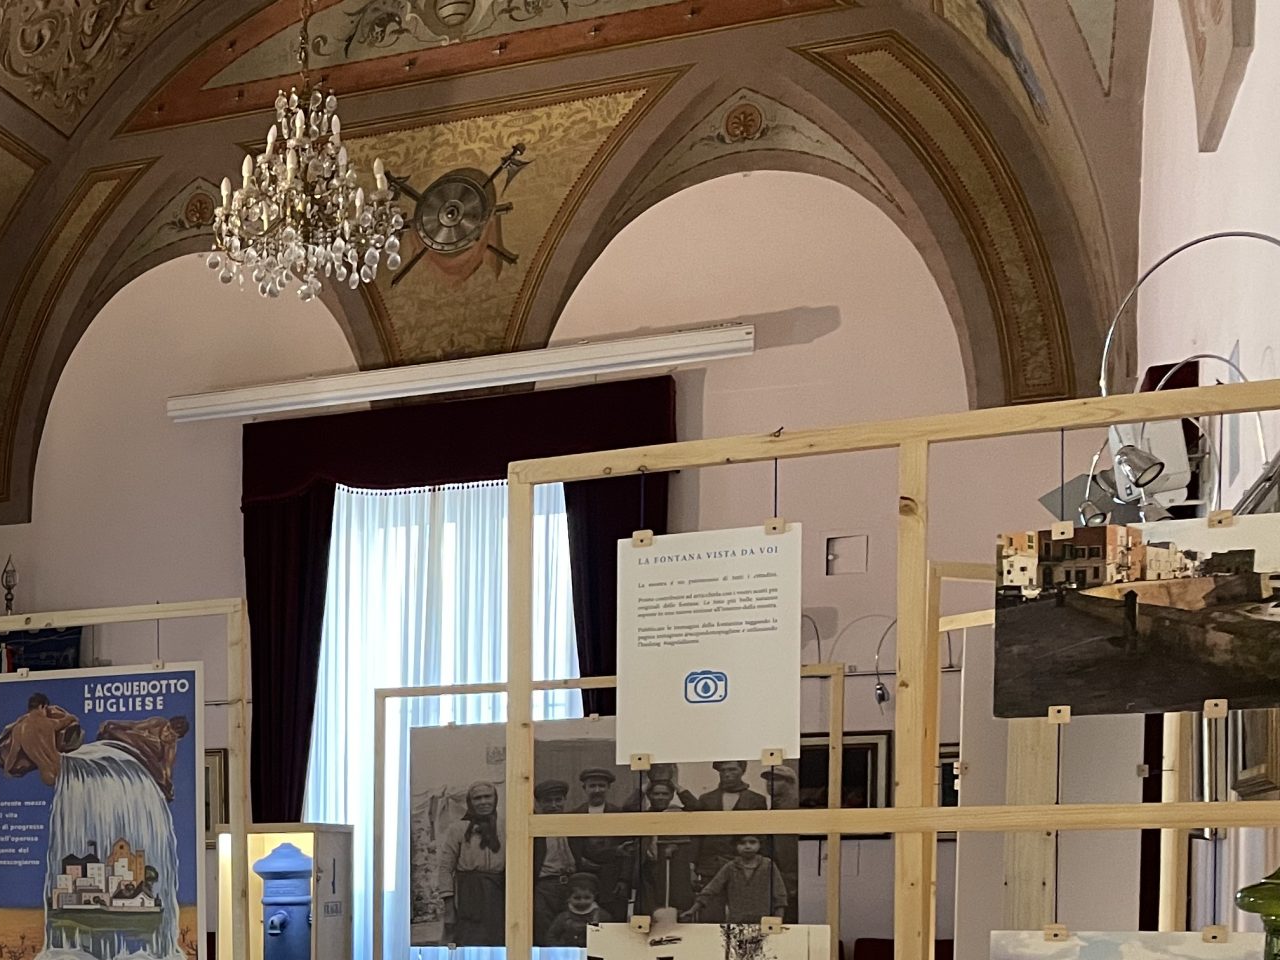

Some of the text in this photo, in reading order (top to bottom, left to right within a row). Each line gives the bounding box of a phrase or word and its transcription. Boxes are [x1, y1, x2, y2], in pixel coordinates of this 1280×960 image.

[654, 553, 702, 564] FONTANA
[706, 549, 737, 559] VISTA
[759, 546, 779, 554] VOI
[84, 679, 189, 698] L'ACQUEDOTTO
[84, 696, 164, 713] PUGLIESE
